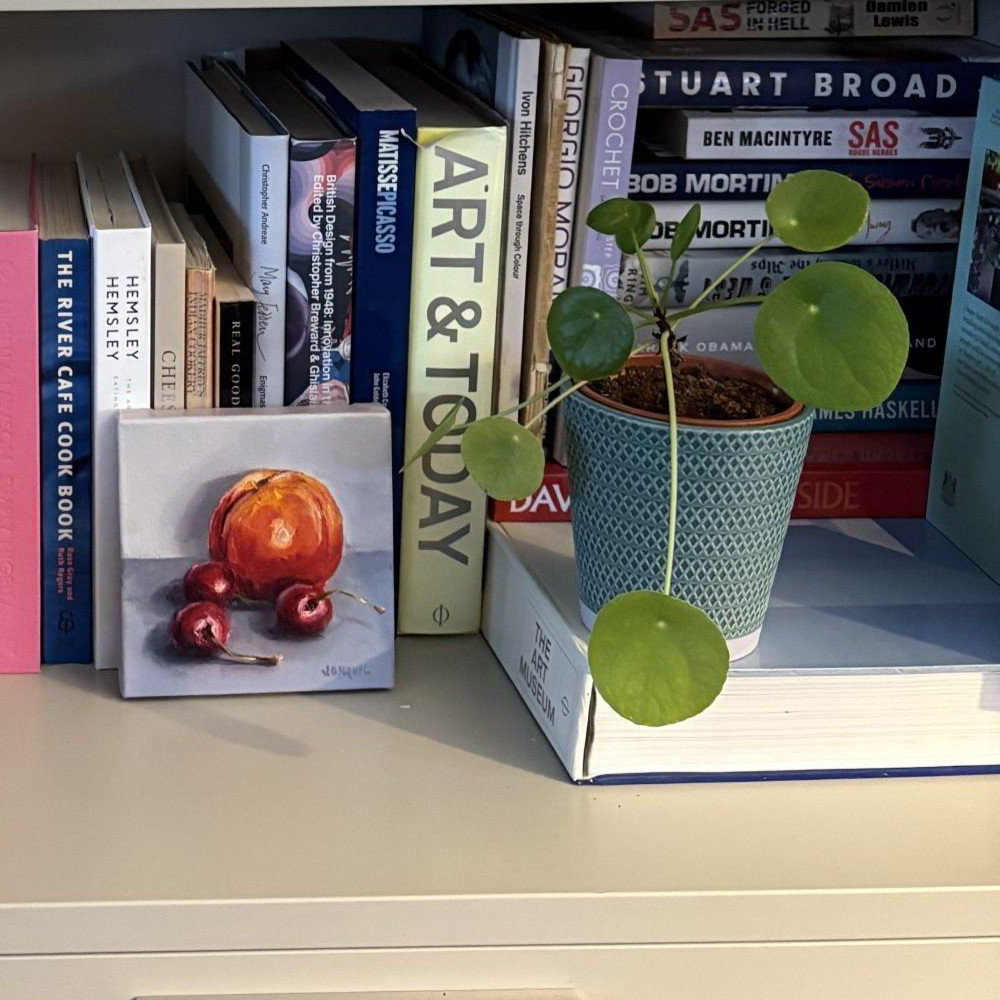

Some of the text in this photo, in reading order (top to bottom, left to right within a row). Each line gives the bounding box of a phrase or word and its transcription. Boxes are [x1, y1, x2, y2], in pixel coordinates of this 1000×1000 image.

[668, 3, 741, 32] SAS
[745, 0, 811, 15] FORGED
[745, 17, 810, 31] IN HELL
[813, 71, 957, 99] BROAD
[601, 82, 631, 190] CROCHET
[702, 129, 833, 147] BEN MACINTYRE
[847, 119, 900, 149] SAS
[512, 90, 534, 280] Ivon Hitchens Space through Colour
[256, 163, 272, 408] Christopher Andreae Enigmas
[308, 173, 325, 363] Edited by Christopher Breward &
[321, 173, 337, 380] British Design from 1948: Innovation
[750, 259, 786, 274] Alps
[105, 275, 121, 361] HEMSLEY
[124, 275, 140, 361] HEMSLEY
[418, 145, 490, 566] ART & TODAY
[695, 341, 754, 354] OBAMA
[56, 248, 75, 541] THE RIVER CAFE COOK BOOK
[230, 320, 242, 406] REAL GOOD
[529, 648, 549, 684] ART
[534, 621, 553, 662] THE
[519, 653, 556, 728] MUSEUM
